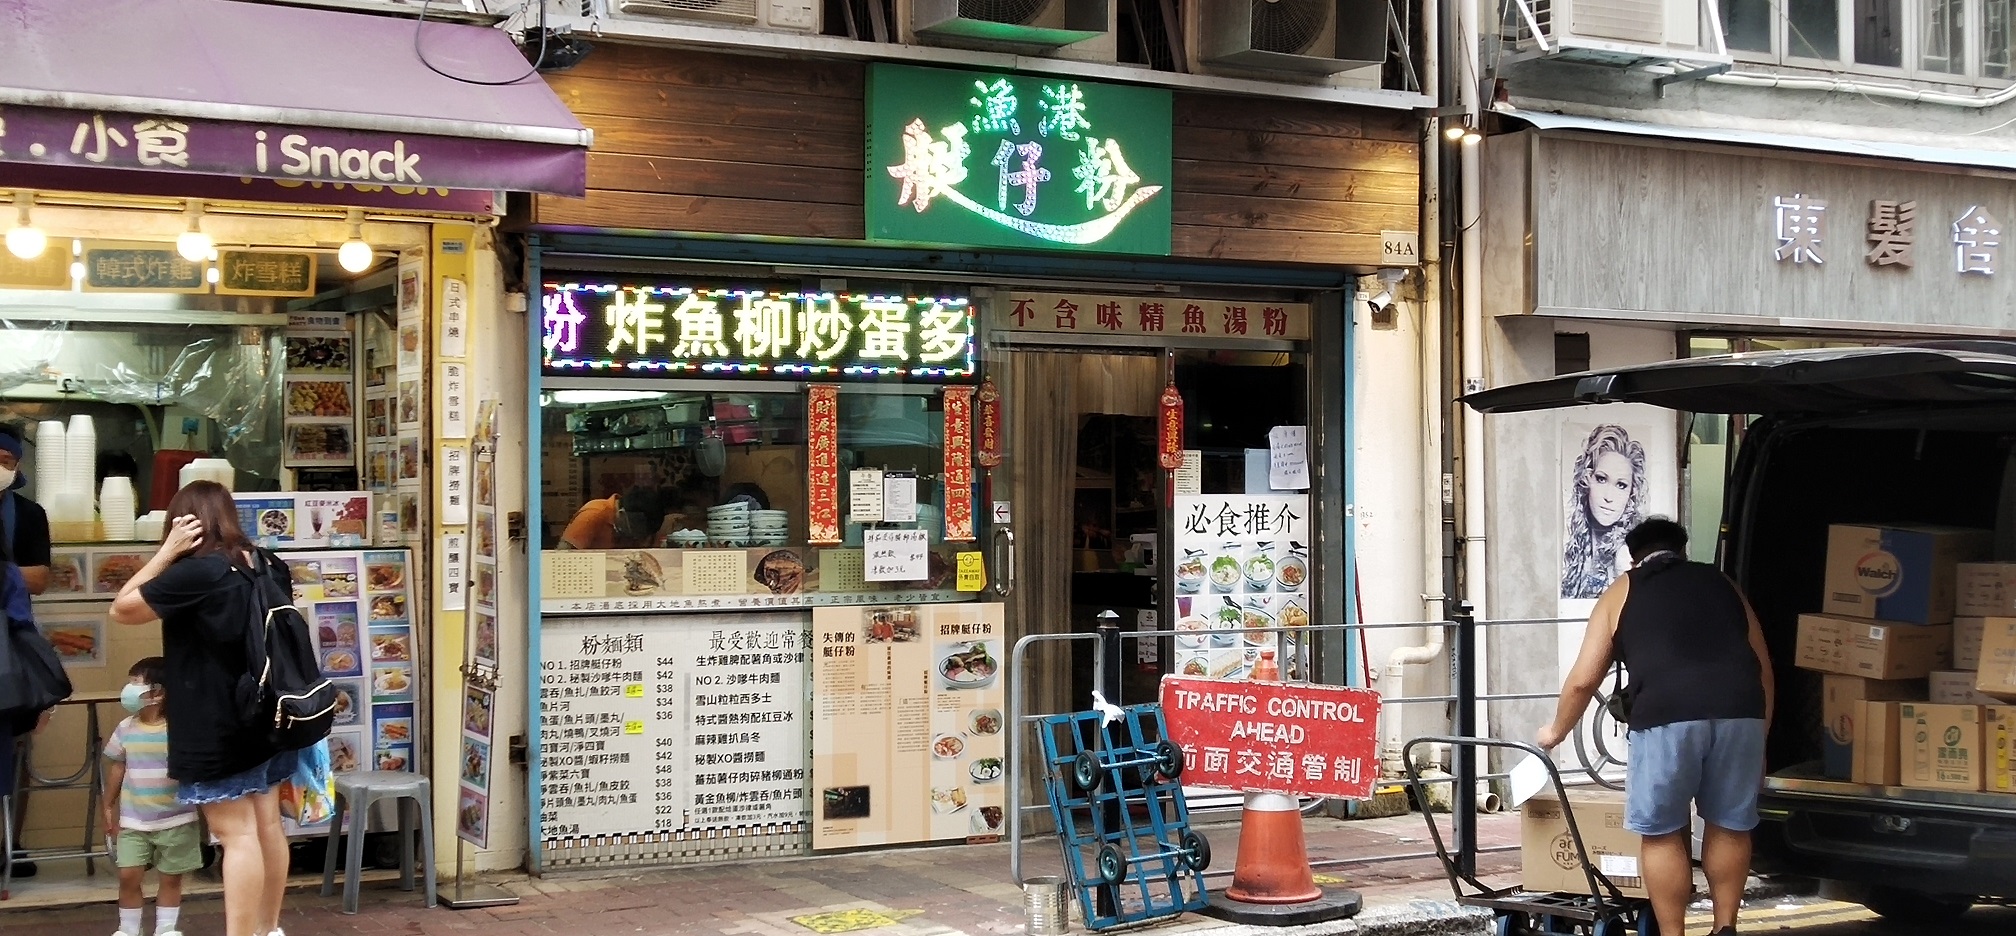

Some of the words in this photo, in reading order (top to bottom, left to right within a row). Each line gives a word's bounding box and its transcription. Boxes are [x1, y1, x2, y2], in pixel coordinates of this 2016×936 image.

[970, 77, 1092, 142] 漁港
[70, 115, 190, 168] 小食
[255, 130, 268, 173] i
[280, 134, 423, 184] Snack
[886, 117, 1163, 245] 艇仔粉
[1772, 191, 2003, 276] 東髮舍
[1384, 240, 1415, 256] 84A
[231, 259, 302, 284] 炸雪糕
[448, 282, 460, 338] 日式串燒
[1009, 299, 1289, 336] 不含味精魚湯粉
[605, 290, 967, 363] 炸魚柳炒蛋多
[447, 365, 460, 422] 脆炸雪糕
[983, 404, 995, 450] 恭喜發財
[815, 399, 831, 519] 財源廣進達三江
[950, 400, 966, 518] 生意興隆通四海
[1183, 501, 1302, 538] 必食推介
[1857, 566, 1897, 581] Walch
[939, 623, 993, 636] 招牌艇仔粉
[578, 633, 644, 655] 粉麵類
[822, 632, 856, 644] 失傳的
[822, 645, 856, 657] 艇仔粉
[570, 657, 622, 671] 招牌艇仔粉
[656, 657, 674, 667] $44
[656, 670, 674, 680] $42
[695, 675, 712, 686] NO
[656, 684, 673, 693] $38
[656, 697, 673, 707] $34
[695, 692, 772, 707] 雪山粒粒西多士
[1174, 689, 1257, 715] TRAFFIC
[1267, 696, 1366, 724] CONTROL
[656, 711, 673, 720] $36
[1228, 720, 1306, 745] AHEAD
[655, 737, 673, 748] $40
[655, 751, 673, 761] $42
[655, 764, 672, 775] $48
[655, 778, 672, 788] $38
[655, 791, 672, 802] $36
[654, 805, 672, 815] $22
[654, 818, 672, 828] $18
